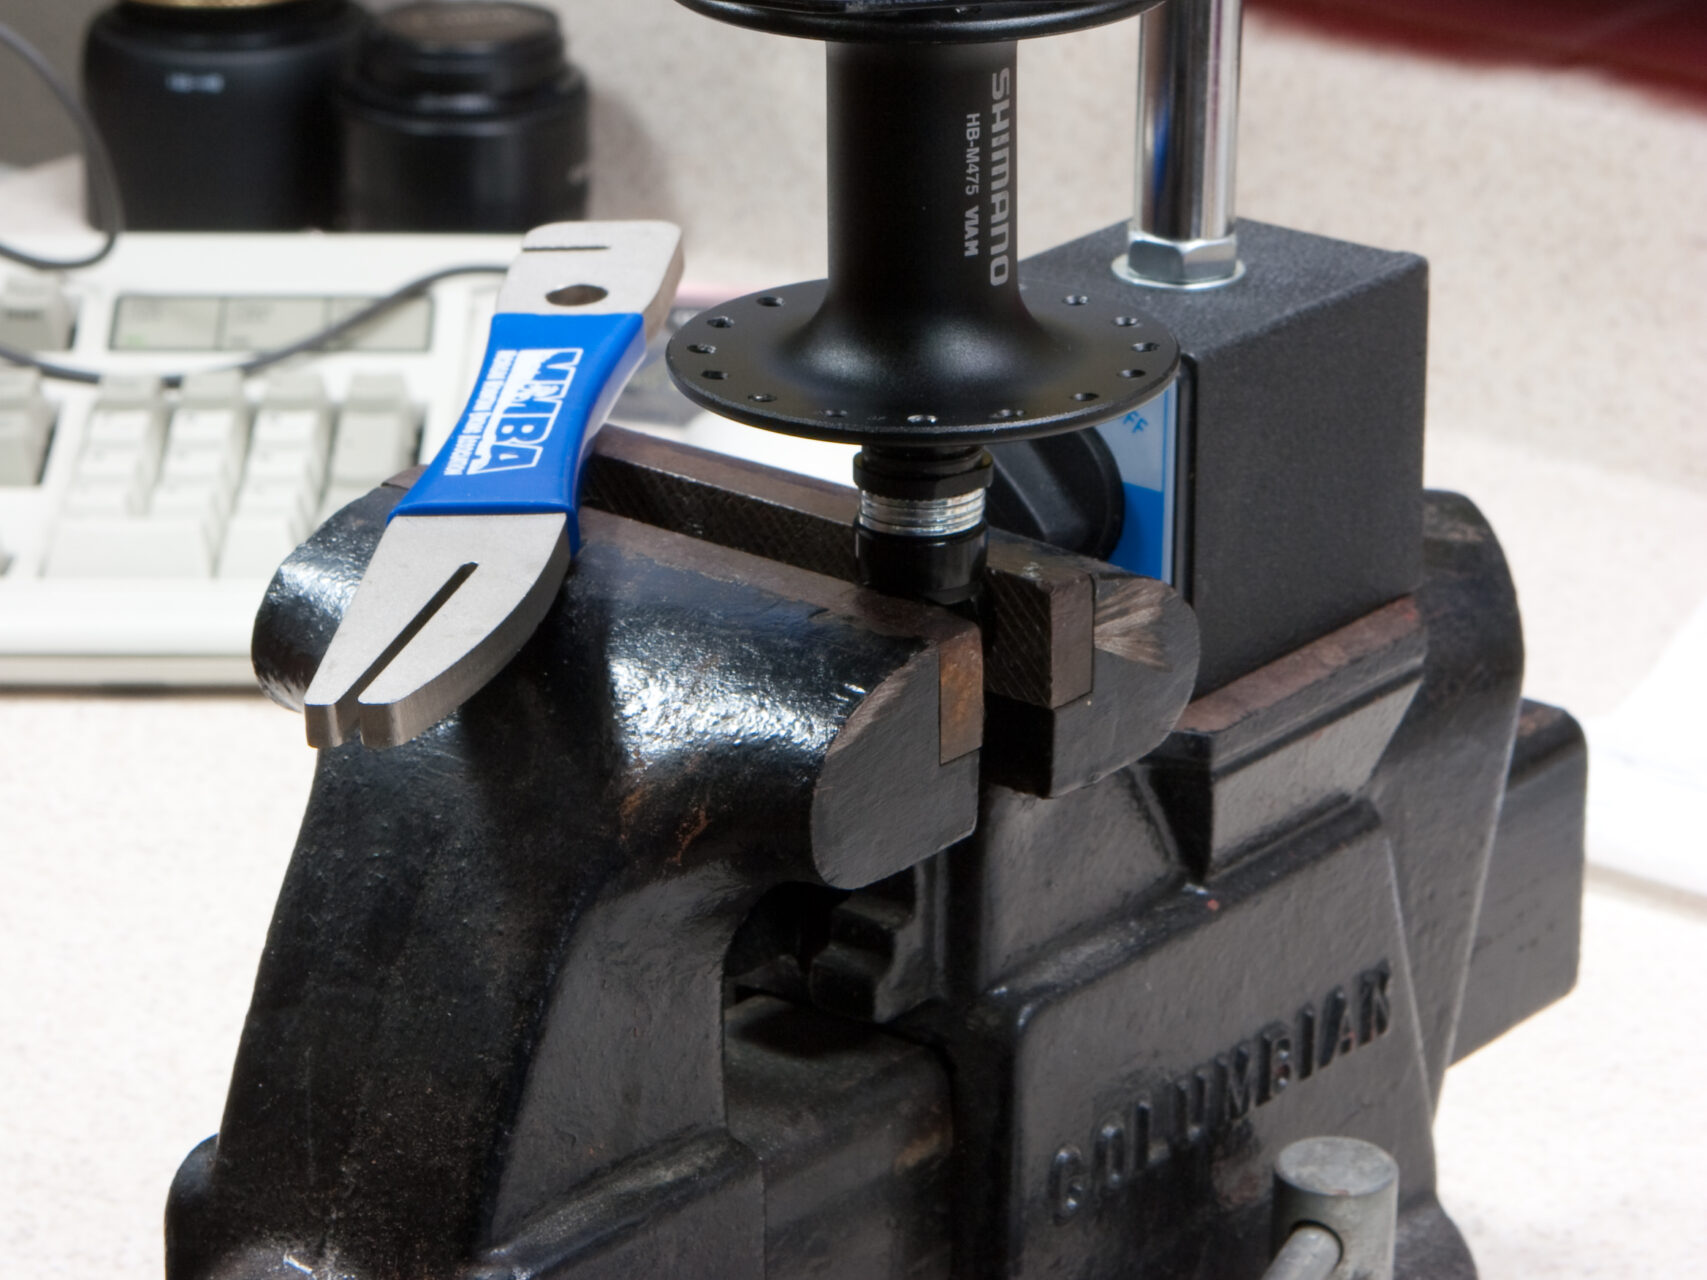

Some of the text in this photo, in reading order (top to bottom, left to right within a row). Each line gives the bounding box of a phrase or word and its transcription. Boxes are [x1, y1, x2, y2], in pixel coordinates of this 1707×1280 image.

[965, 113, 981, 196] HB-M475
[990, 67, 1010, 287] SHIMANO
[1050, 958, 1392, 1223] COLUMBIAN
